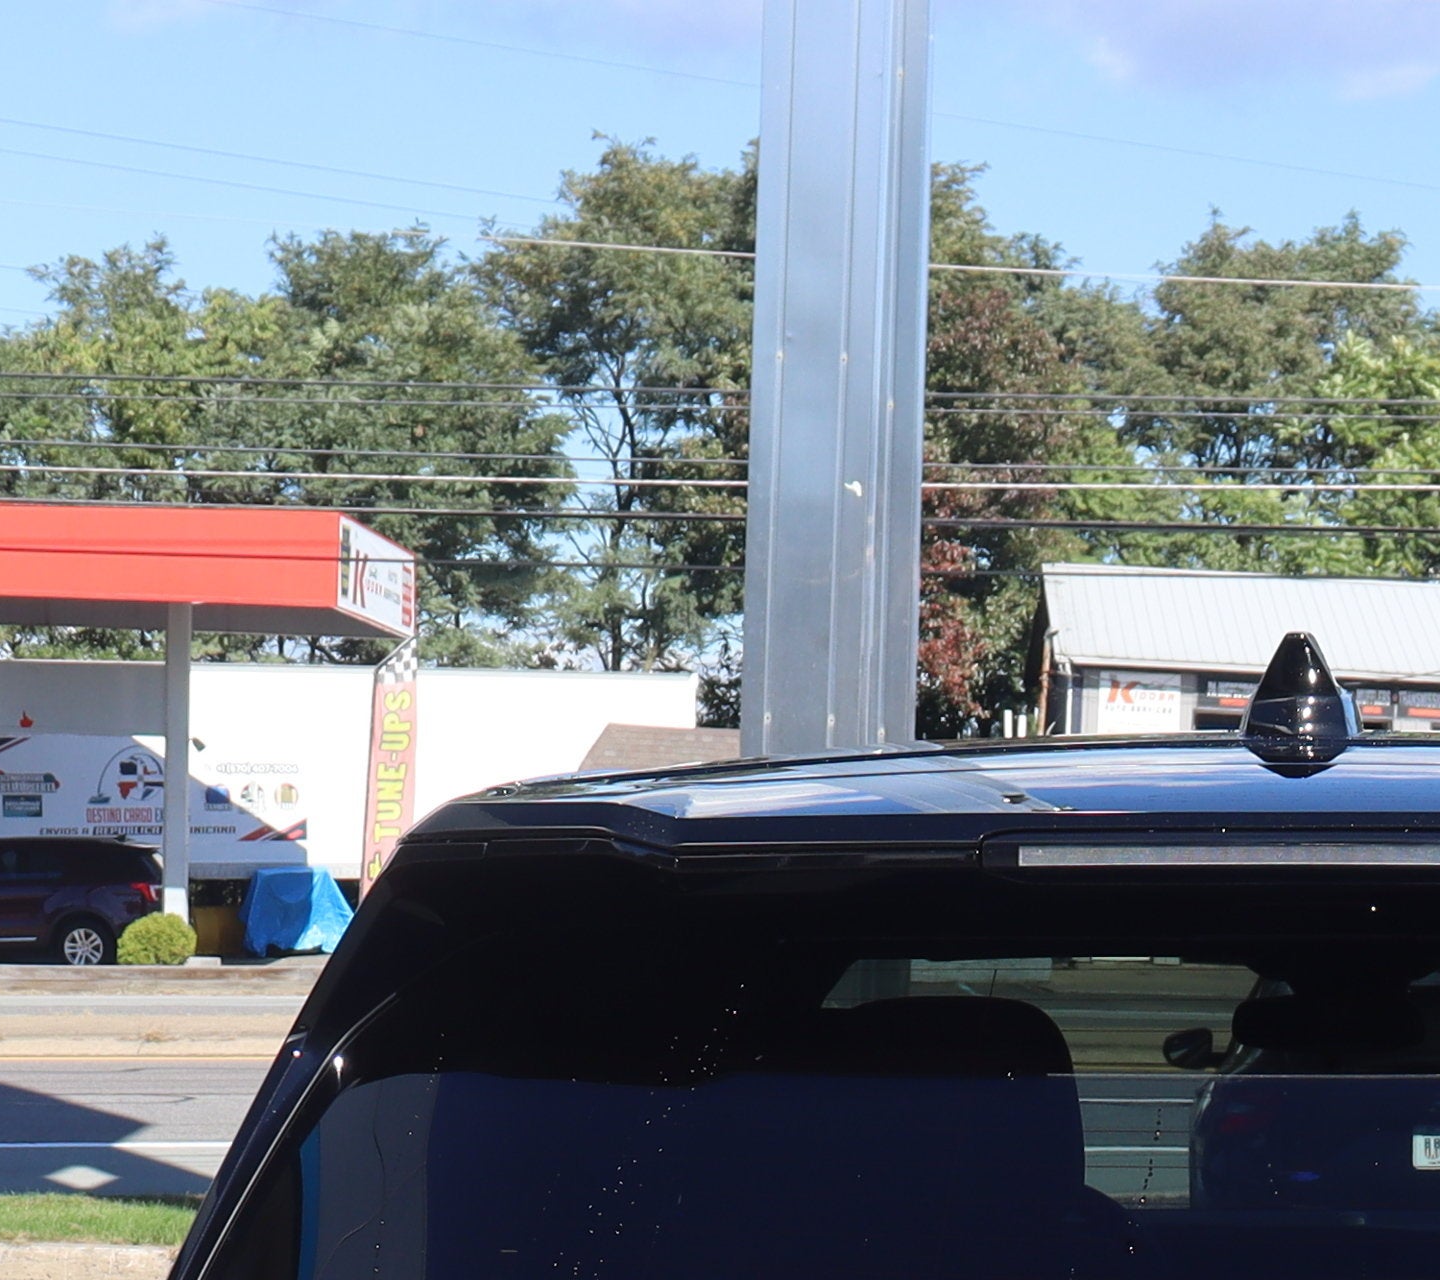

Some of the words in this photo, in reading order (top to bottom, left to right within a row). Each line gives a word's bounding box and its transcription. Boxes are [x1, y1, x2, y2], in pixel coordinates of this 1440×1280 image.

[372, 689, 412, 843] TUNE-UPS
[86, 807, 122, 823] DESTINO
[123, 807, 153, 823] CARGO
